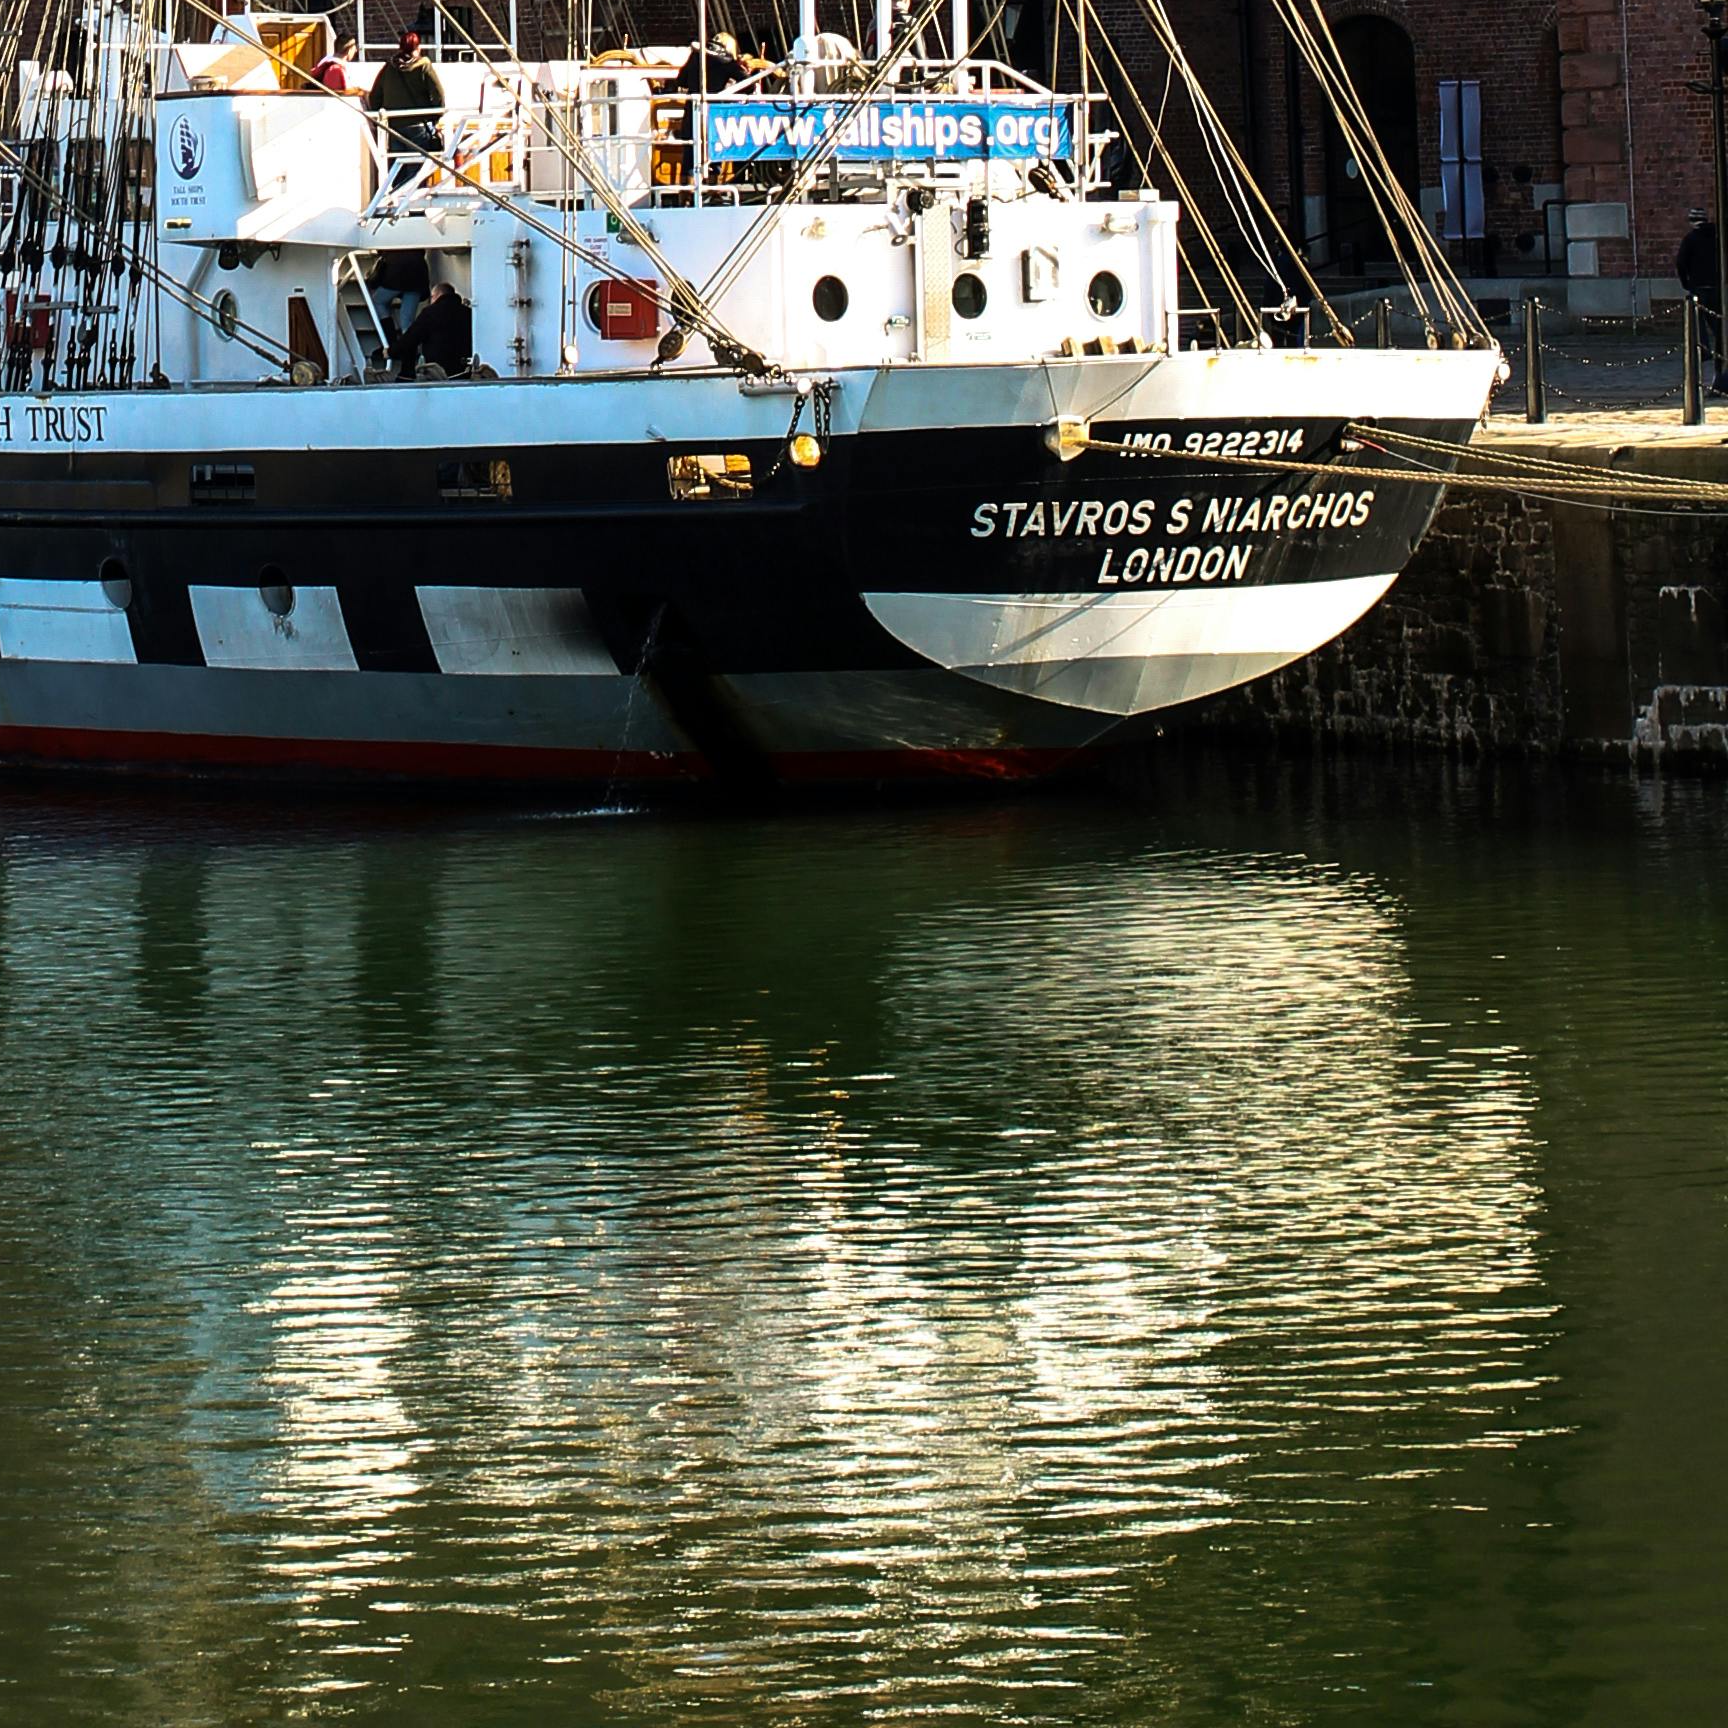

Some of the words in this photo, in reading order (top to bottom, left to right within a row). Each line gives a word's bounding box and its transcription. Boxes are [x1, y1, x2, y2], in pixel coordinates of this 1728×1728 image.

[25, 406, 108, 442] TRUST
[1120, 432, 1172, 458] IMO
[1181, 428, 1304, 457] 9222314
[970, 499, 1155, 538] STAVROS
[1166, 497, 1194, 536] S
[1202, 490, 1375, 534] NIARCHOS
[1097, 544, 1253, 585] LONDON
